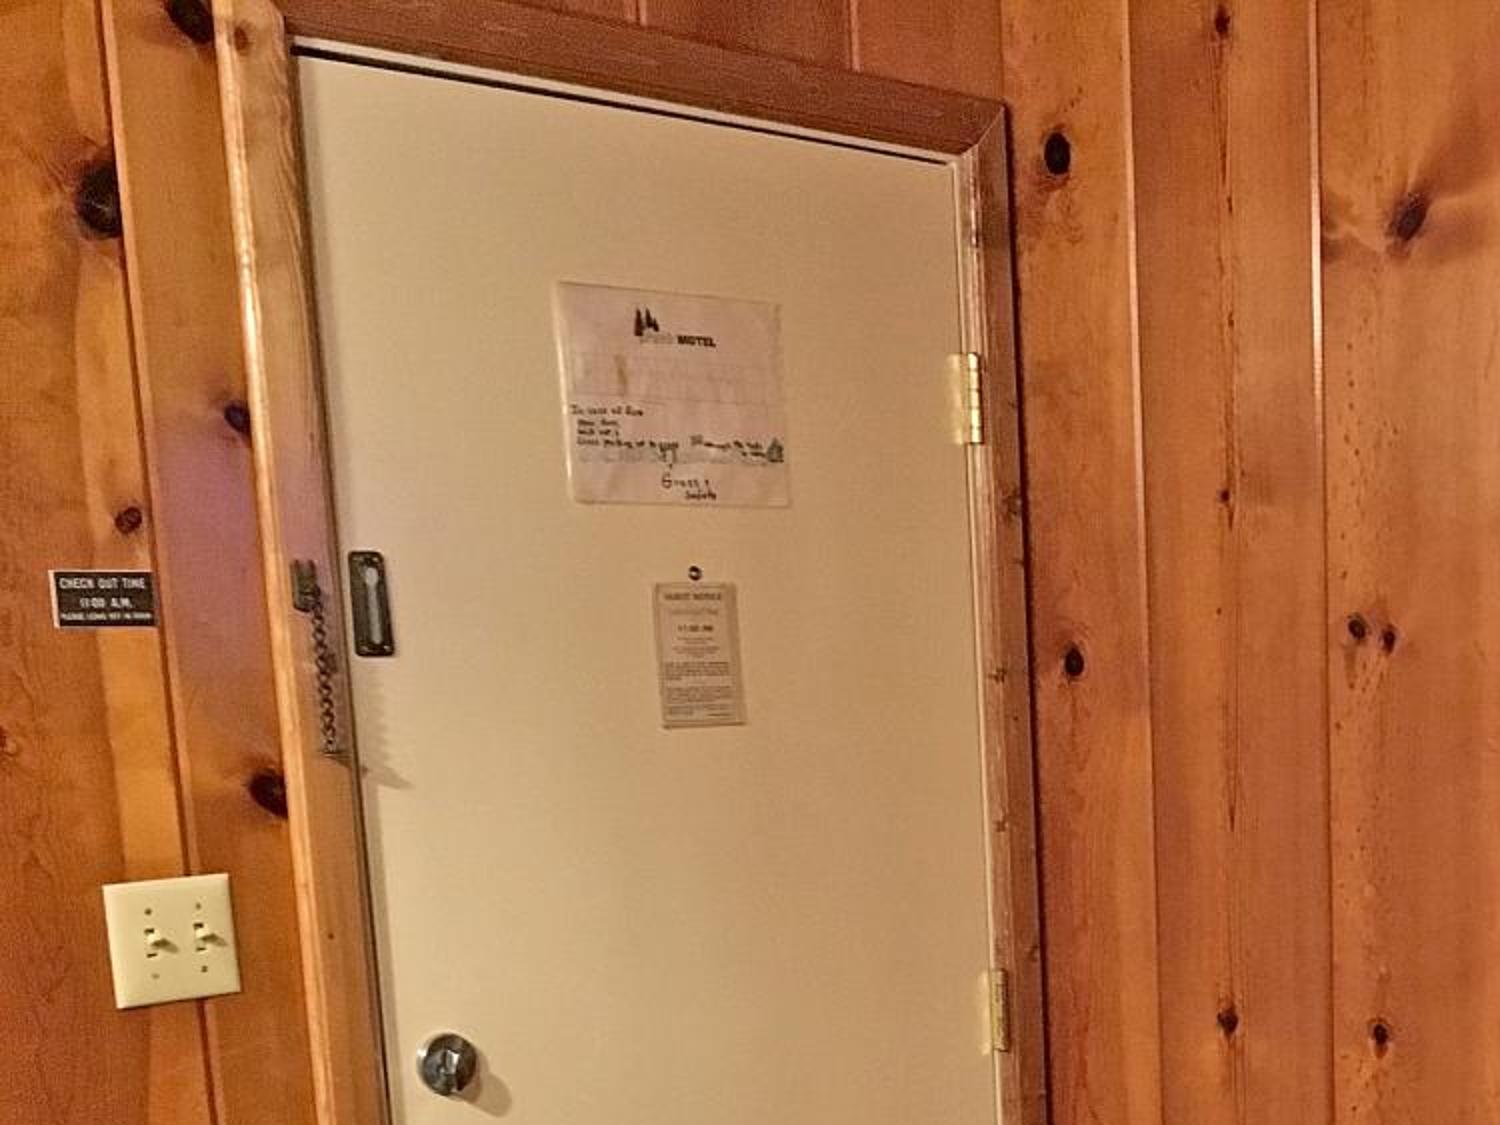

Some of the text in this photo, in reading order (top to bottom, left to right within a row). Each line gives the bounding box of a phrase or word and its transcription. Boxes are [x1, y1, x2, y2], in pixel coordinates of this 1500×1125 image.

[677, 335, 717, 348] MOTEL
[59, 577, 145, 589] CHECK OUT TIME
